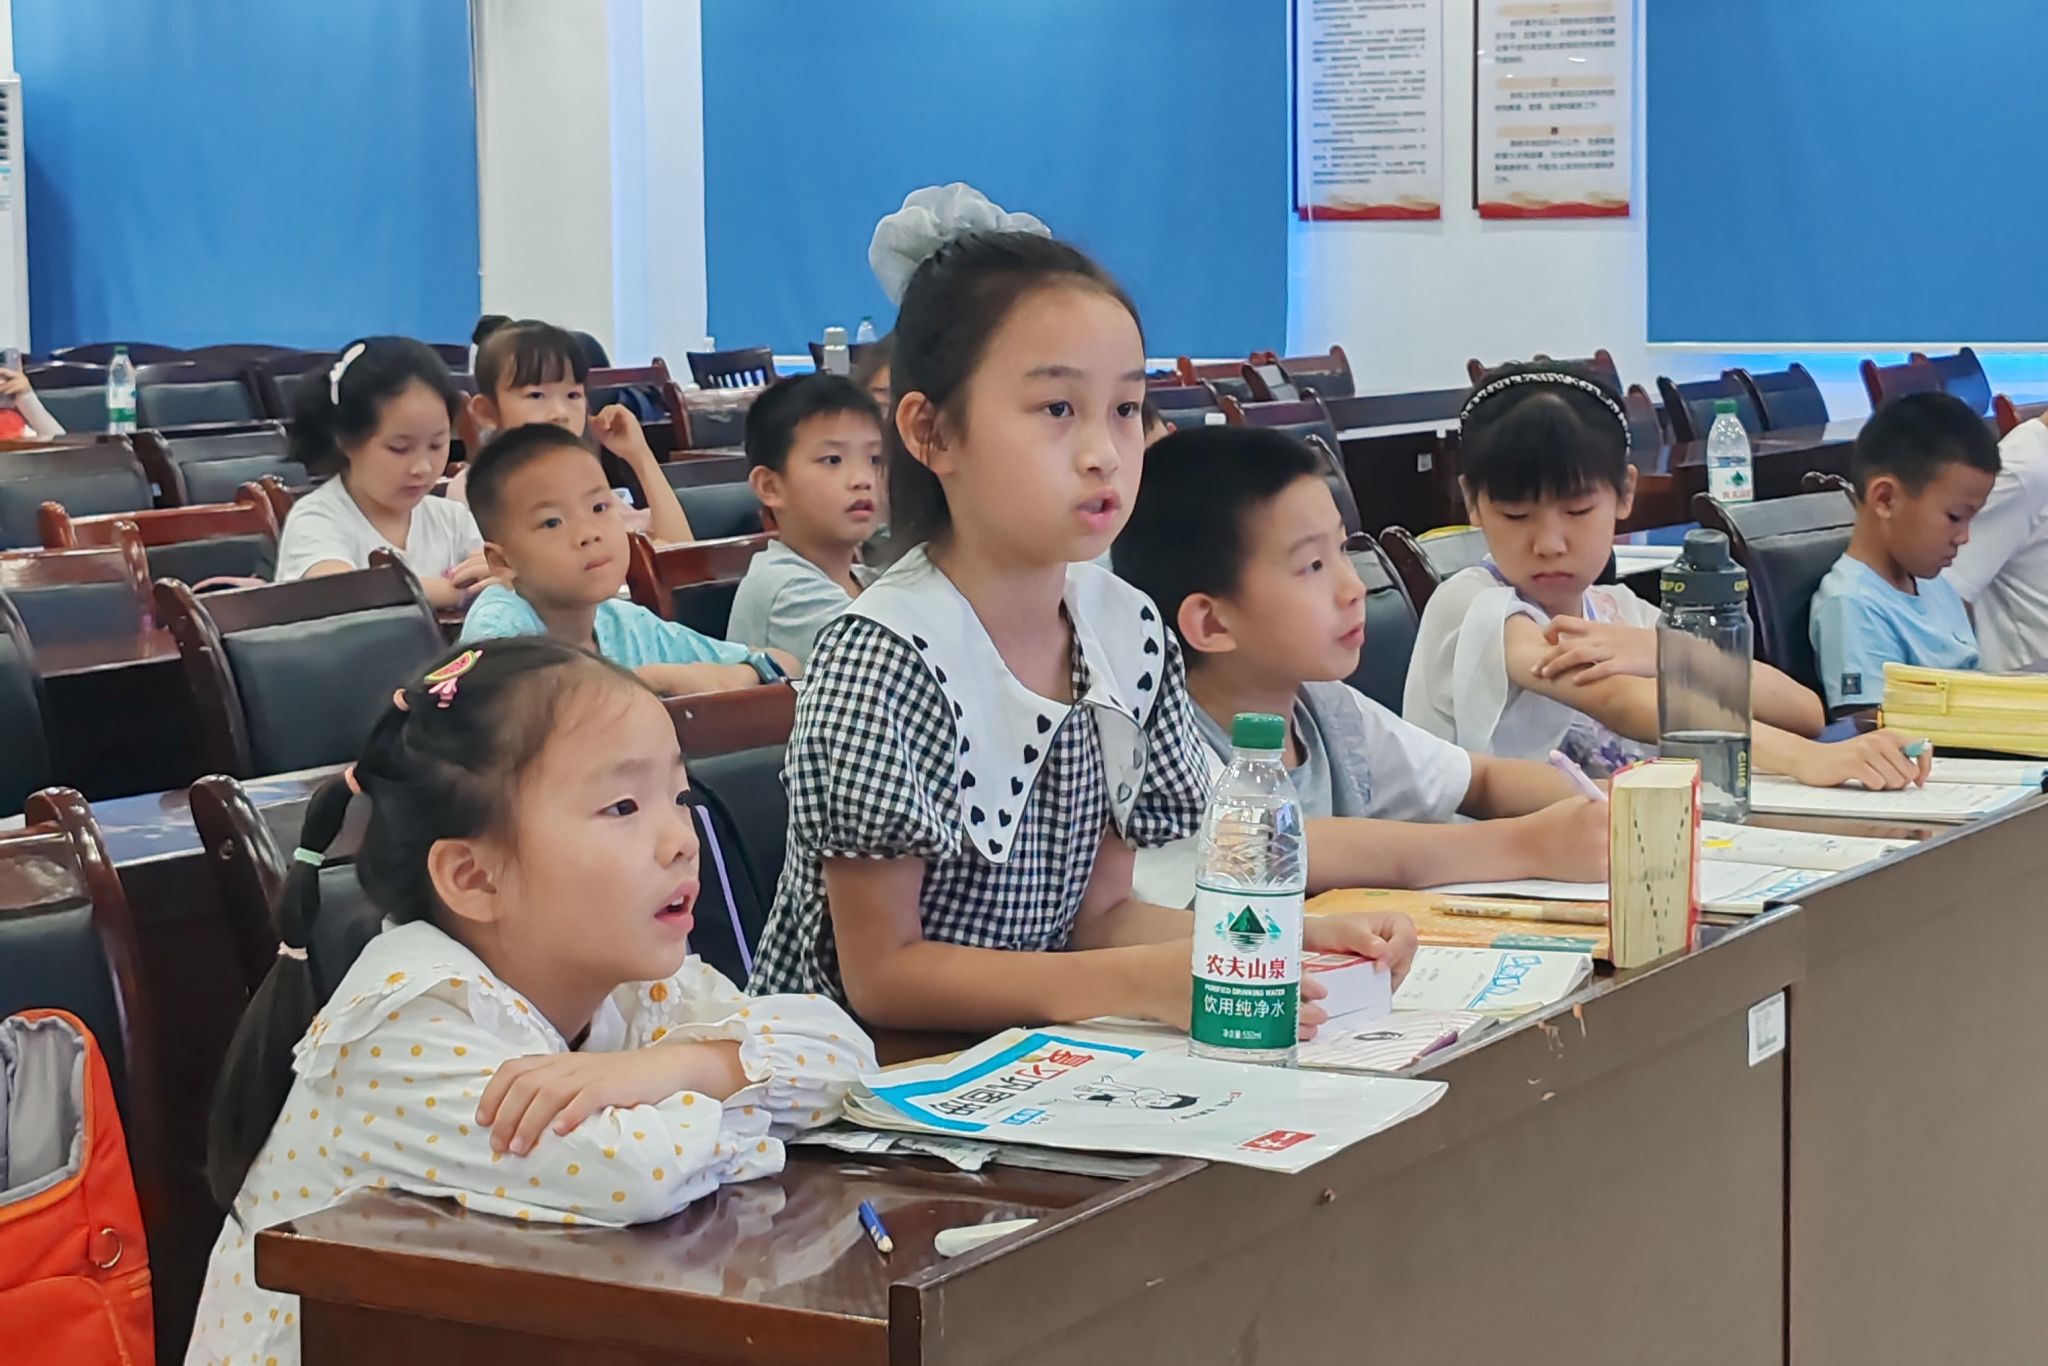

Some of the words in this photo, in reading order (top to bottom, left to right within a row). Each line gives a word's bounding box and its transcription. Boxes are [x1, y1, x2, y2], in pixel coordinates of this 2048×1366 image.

[1207, 954, 1286, 979] 农夫山泉
[1204, 994, 1285, 1018] 饮用纯净水
